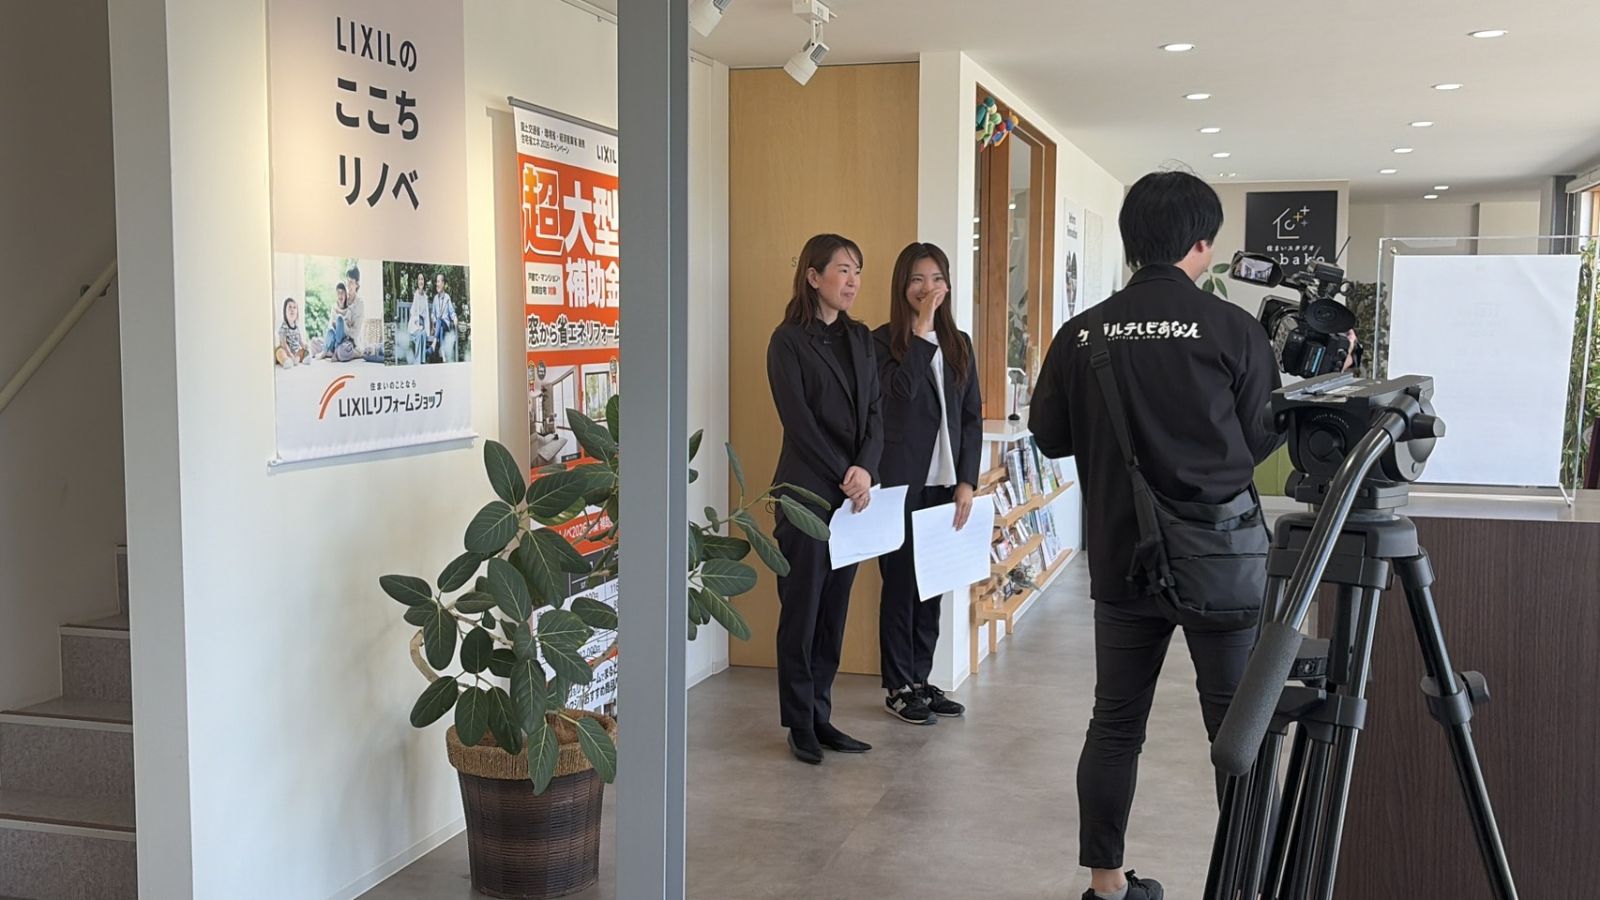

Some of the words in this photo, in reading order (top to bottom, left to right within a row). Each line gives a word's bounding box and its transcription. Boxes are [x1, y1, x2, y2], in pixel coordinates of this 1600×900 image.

[336, 16, 417, 72] LIXILの
[335, 77, 419, 140] ここち
[596, 144, 617, 164] LIXIL
[338, 154, 420, 211] リノベ
[1279, 253, 1326, 265] bako
[566, 256, 619, 309] 補助金
[338, 388, 443, 418] LIXILリフォームショップ
[369, 379, 417, 391] 住まいのことなら
